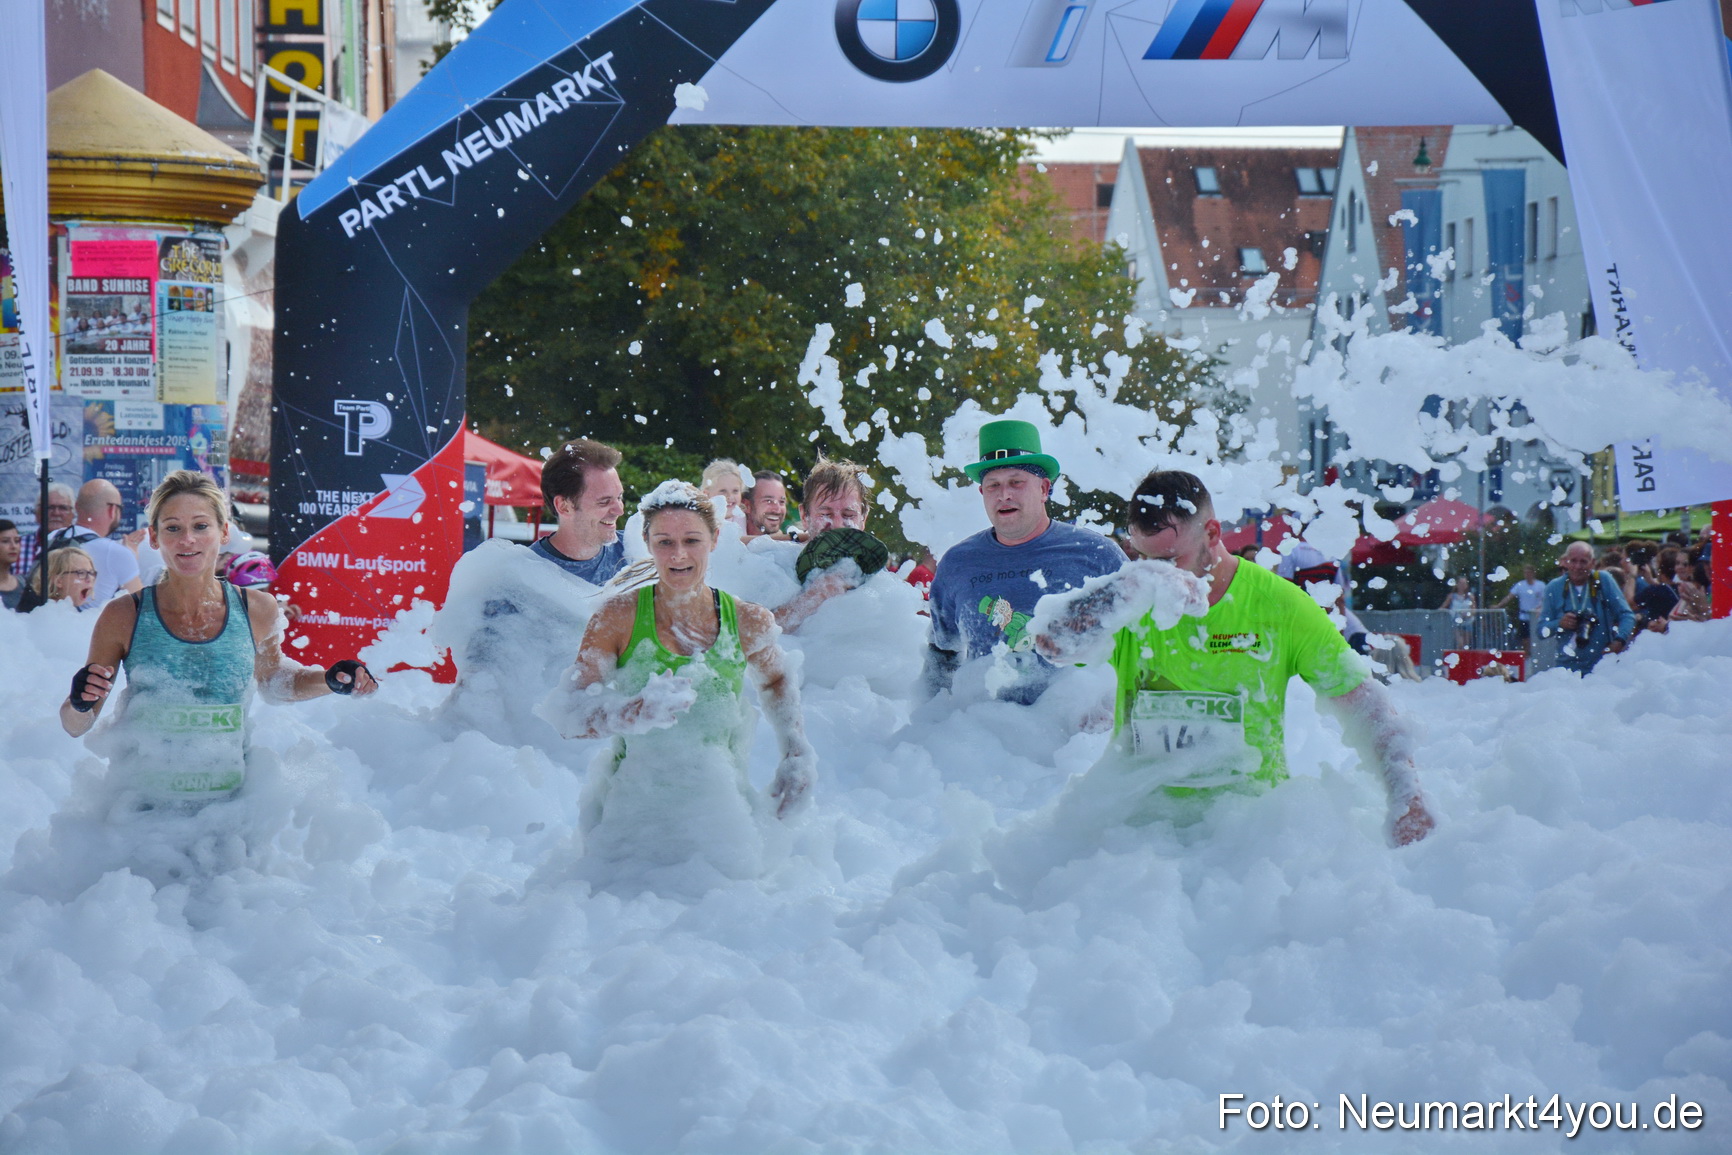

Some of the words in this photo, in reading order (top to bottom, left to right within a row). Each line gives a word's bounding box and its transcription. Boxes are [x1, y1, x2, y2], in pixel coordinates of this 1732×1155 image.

[338, 163, 446, 238] PARTL
[440, 51, 618, 176] NEUMARKT
[67, 278, 98, 292] BAND
[102, 278, 149, 293] SUNRISE
[105, 339, 118, 351] 20
[121, 339, 150, 351] JAHRE
[69, 356, 116, 365] Gottesdienst
[124, 357, 150, 365] Konzert
[69, 367, 104, 377] 21.09.19
[112, 367, 134, 377] 18.30
[136, 367, 150, 377] Uhr
[81, 379, 115, 387] Hofkirche
[117, 379, 151, 388] Neumarkt
[84, 434, 164, 448] Erntedankfest
[166, 436, 188, 448] 2019
[316, 490, 339, 502] THE
[341, 491, 376, 504] NEXT
[298, 502, 317, 514] 100
[318, 503, 360, 516] YEARS
[296, 551, 339, 568] BMW
[344, 554, 426, 575] Laufsport
